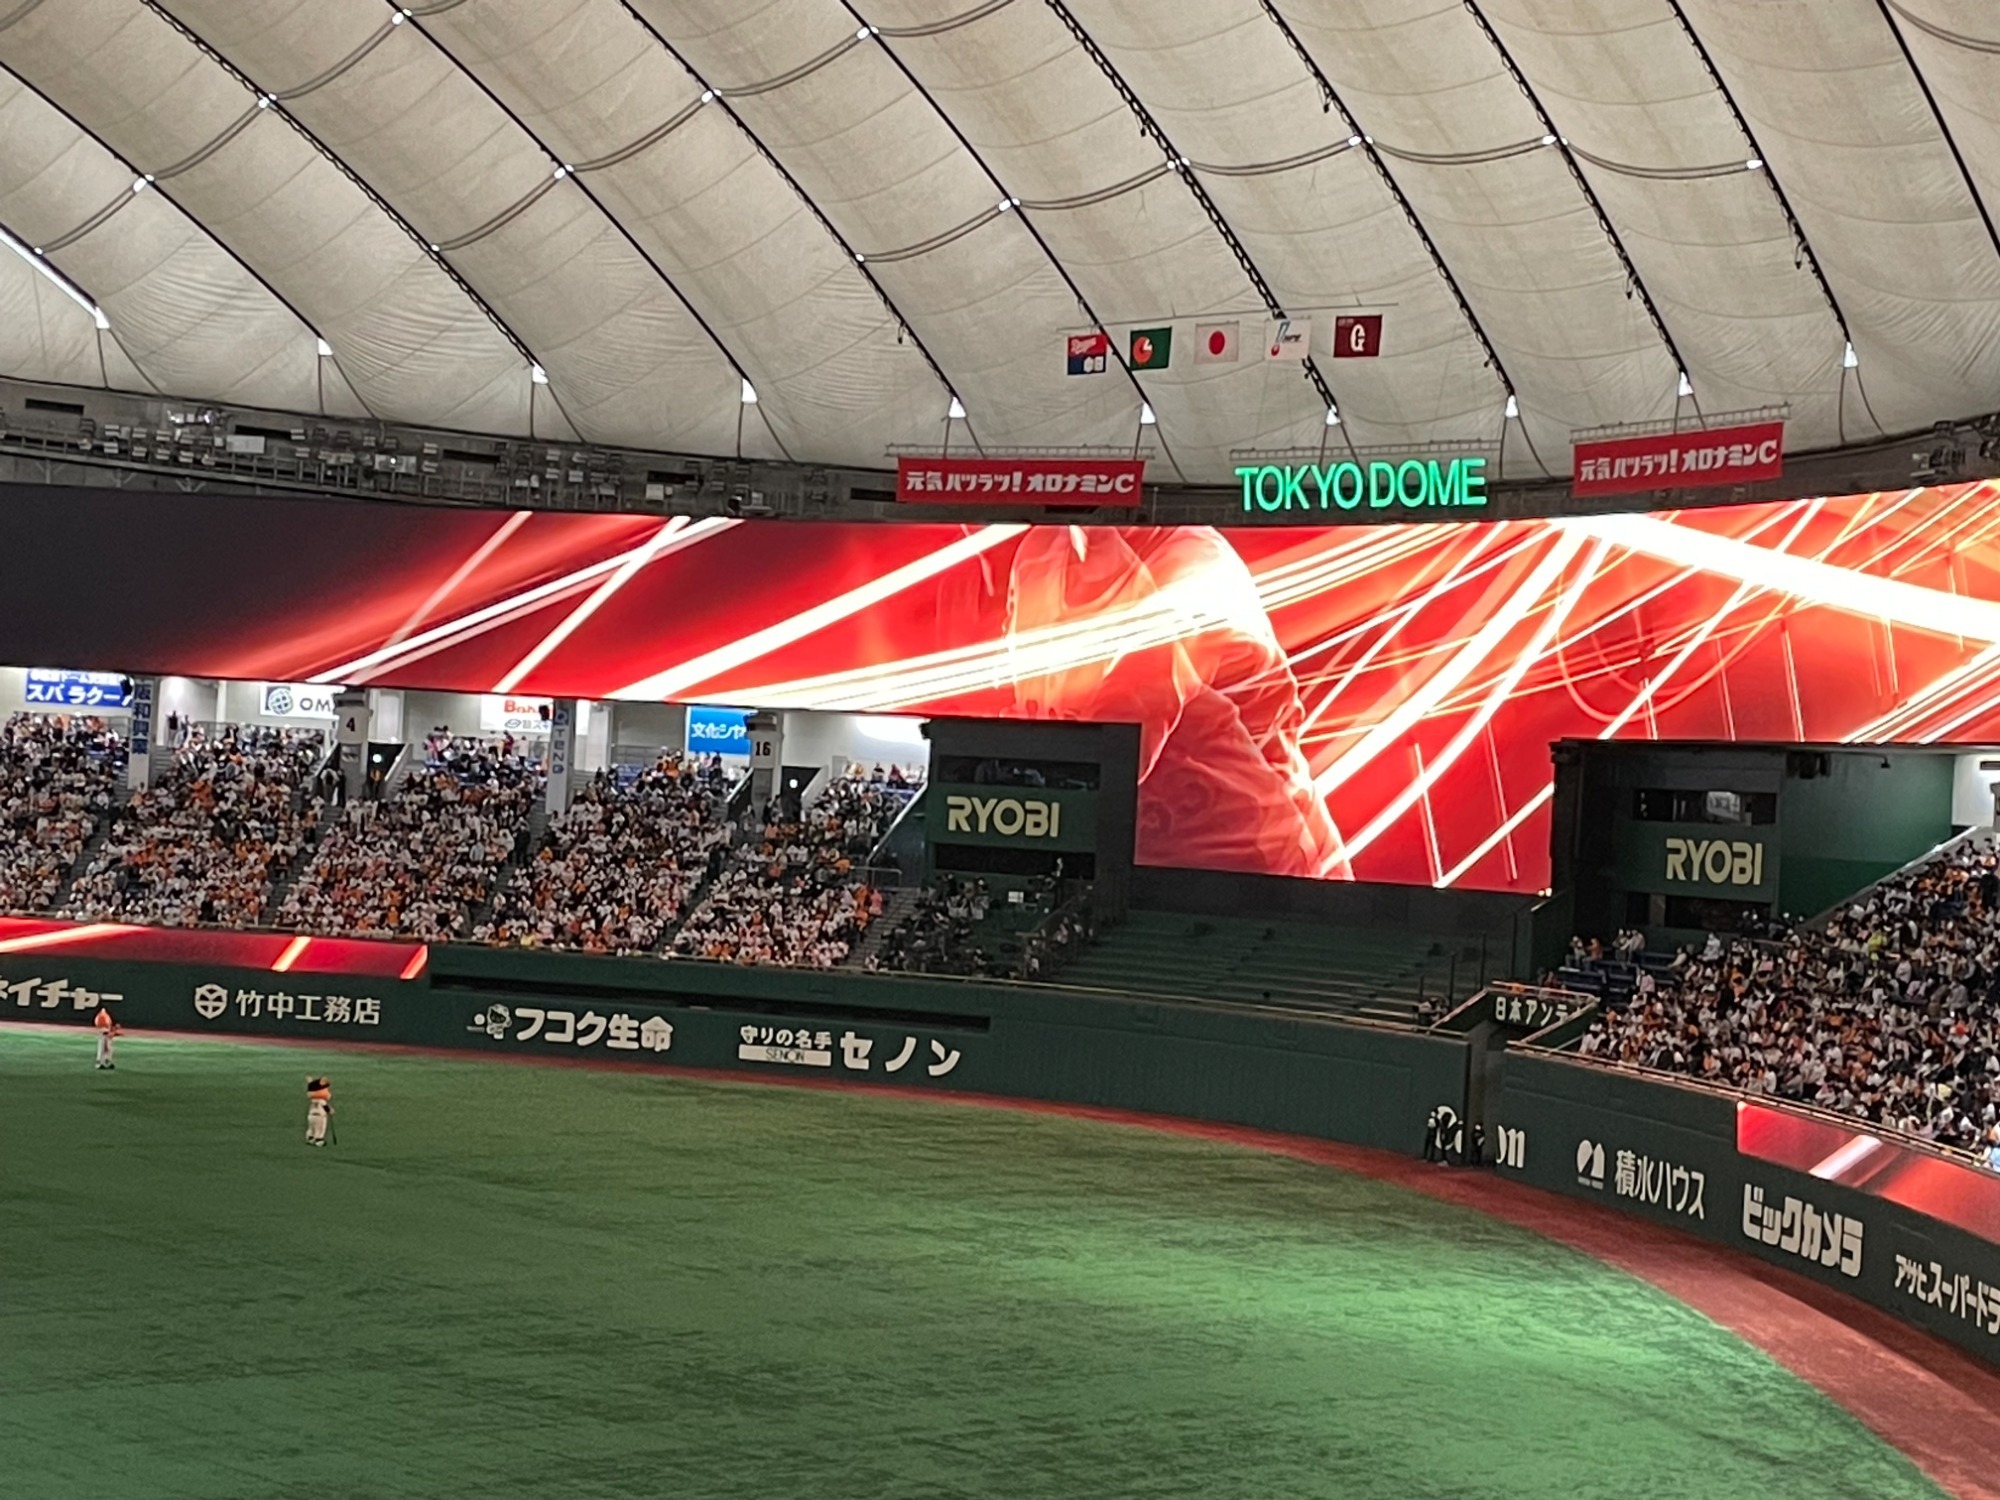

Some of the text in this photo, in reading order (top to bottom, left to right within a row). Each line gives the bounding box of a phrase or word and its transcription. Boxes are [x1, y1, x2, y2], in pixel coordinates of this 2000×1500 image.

[1235, 458, 1487, 512] TOKYO DOME
[345, 717, 356, 732] 4
[755, 741, 771, 756] 16
[947, 795, 1060, 838] RYOBI
[1666, 838, 1763, 886] RYOBI
[235, 989, 381, 1025] 竹中工務店
[1495, 996, 1581, 1027] 日本アンテ
[515, 1007, 674, 1052] フコク生命
[740, 1025, 832, 1050] 守りの名手
[840, 1031, 961, 1077] セノン
[1614, 1149, 1704, 1220] 積水ハウス
[1743, 1183, 1863, 1277] ビックカメラ
